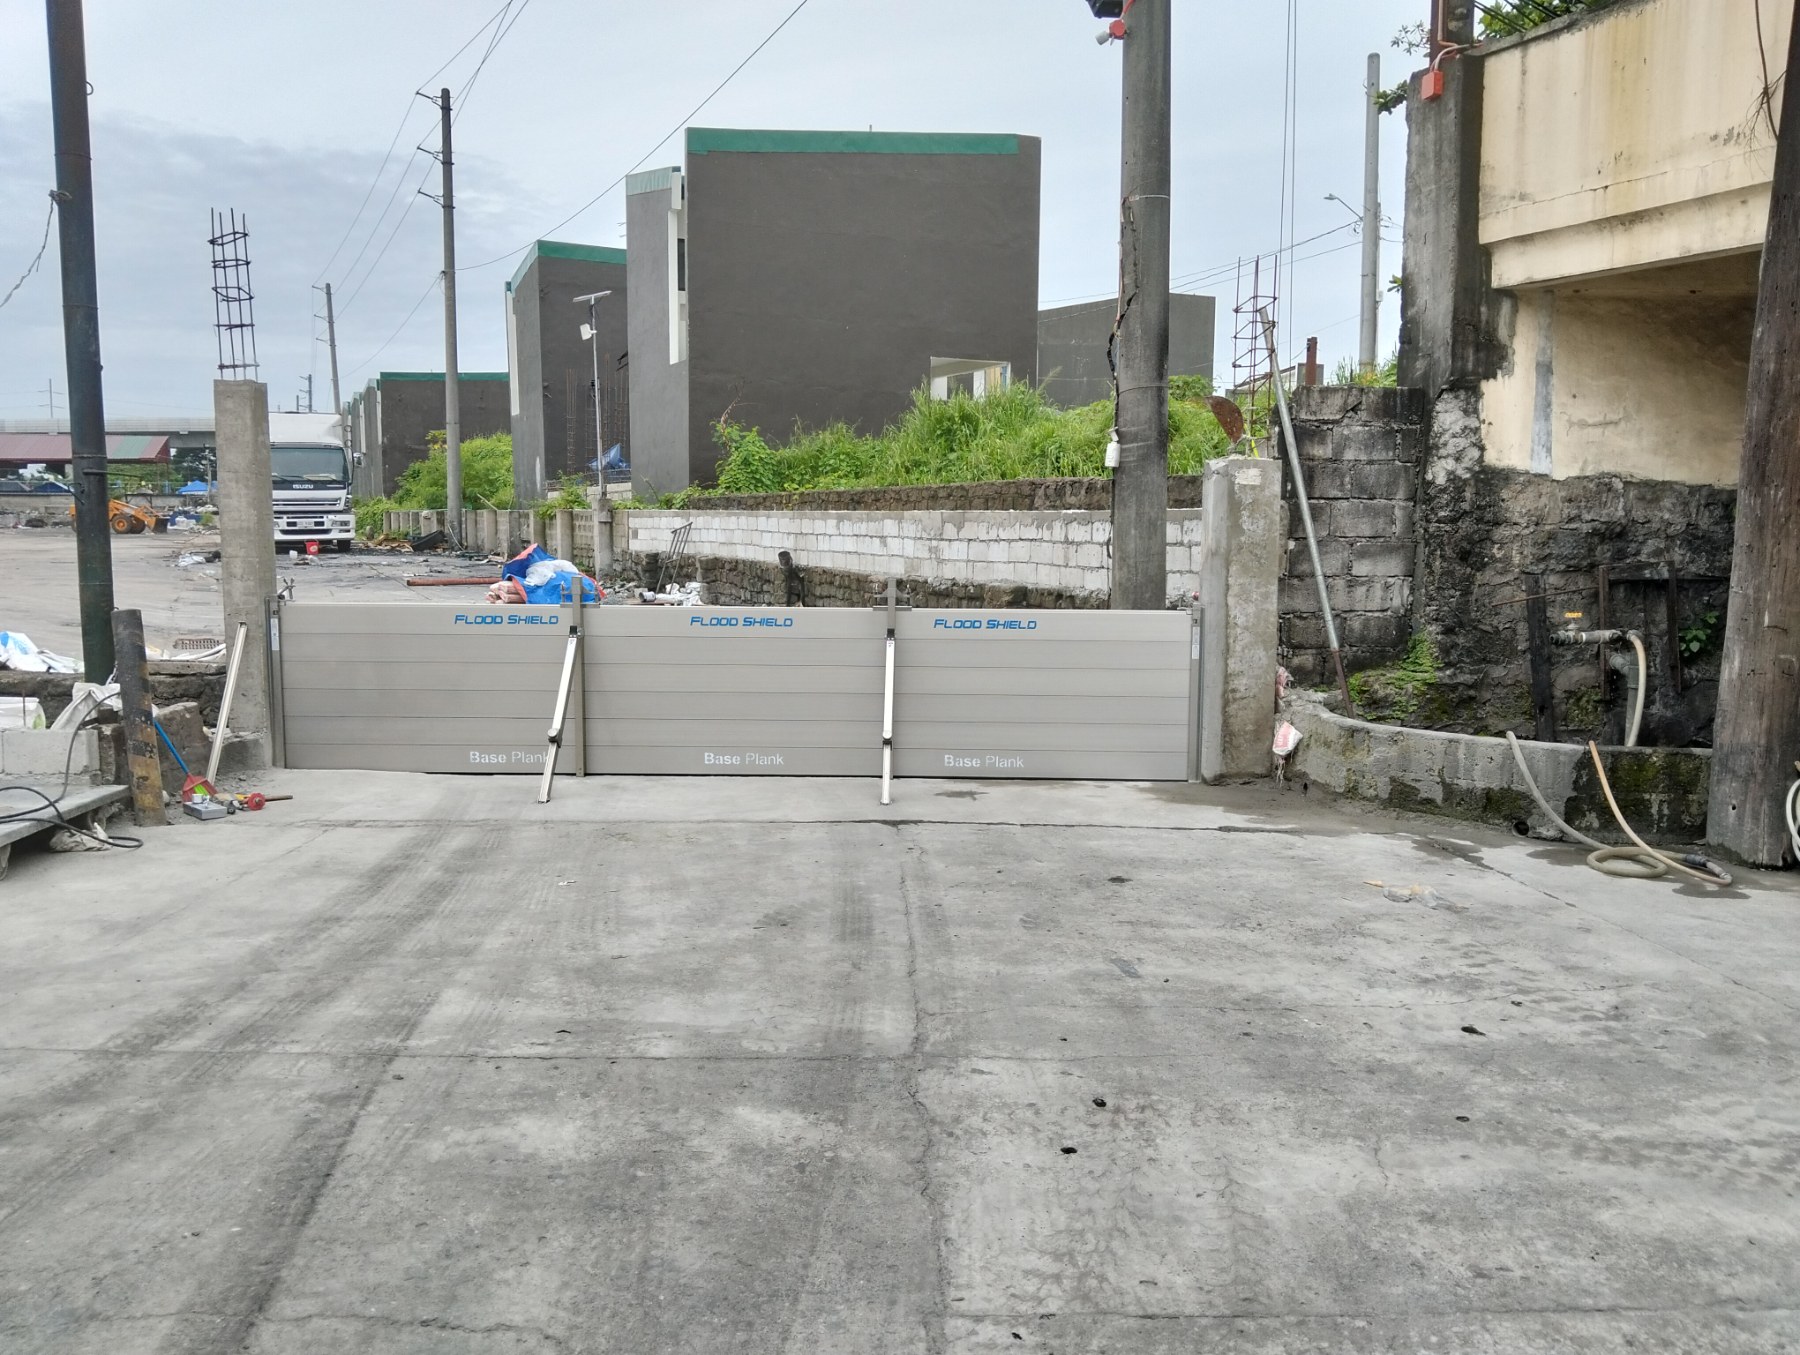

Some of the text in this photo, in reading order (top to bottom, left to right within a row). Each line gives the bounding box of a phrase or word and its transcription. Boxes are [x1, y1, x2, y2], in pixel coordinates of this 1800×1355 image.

[454, 613, 559, 626] FLOOD SHIELD
[689, 615, 794, 628] FLOOD SHIELD
[933, 617, 1038, 630] FLOOD SHIELD
[469, 751, 506, 763] Base
[704, 752, 784, 766] Base Plank
[944, 754, 1025, 768] Base Plank
